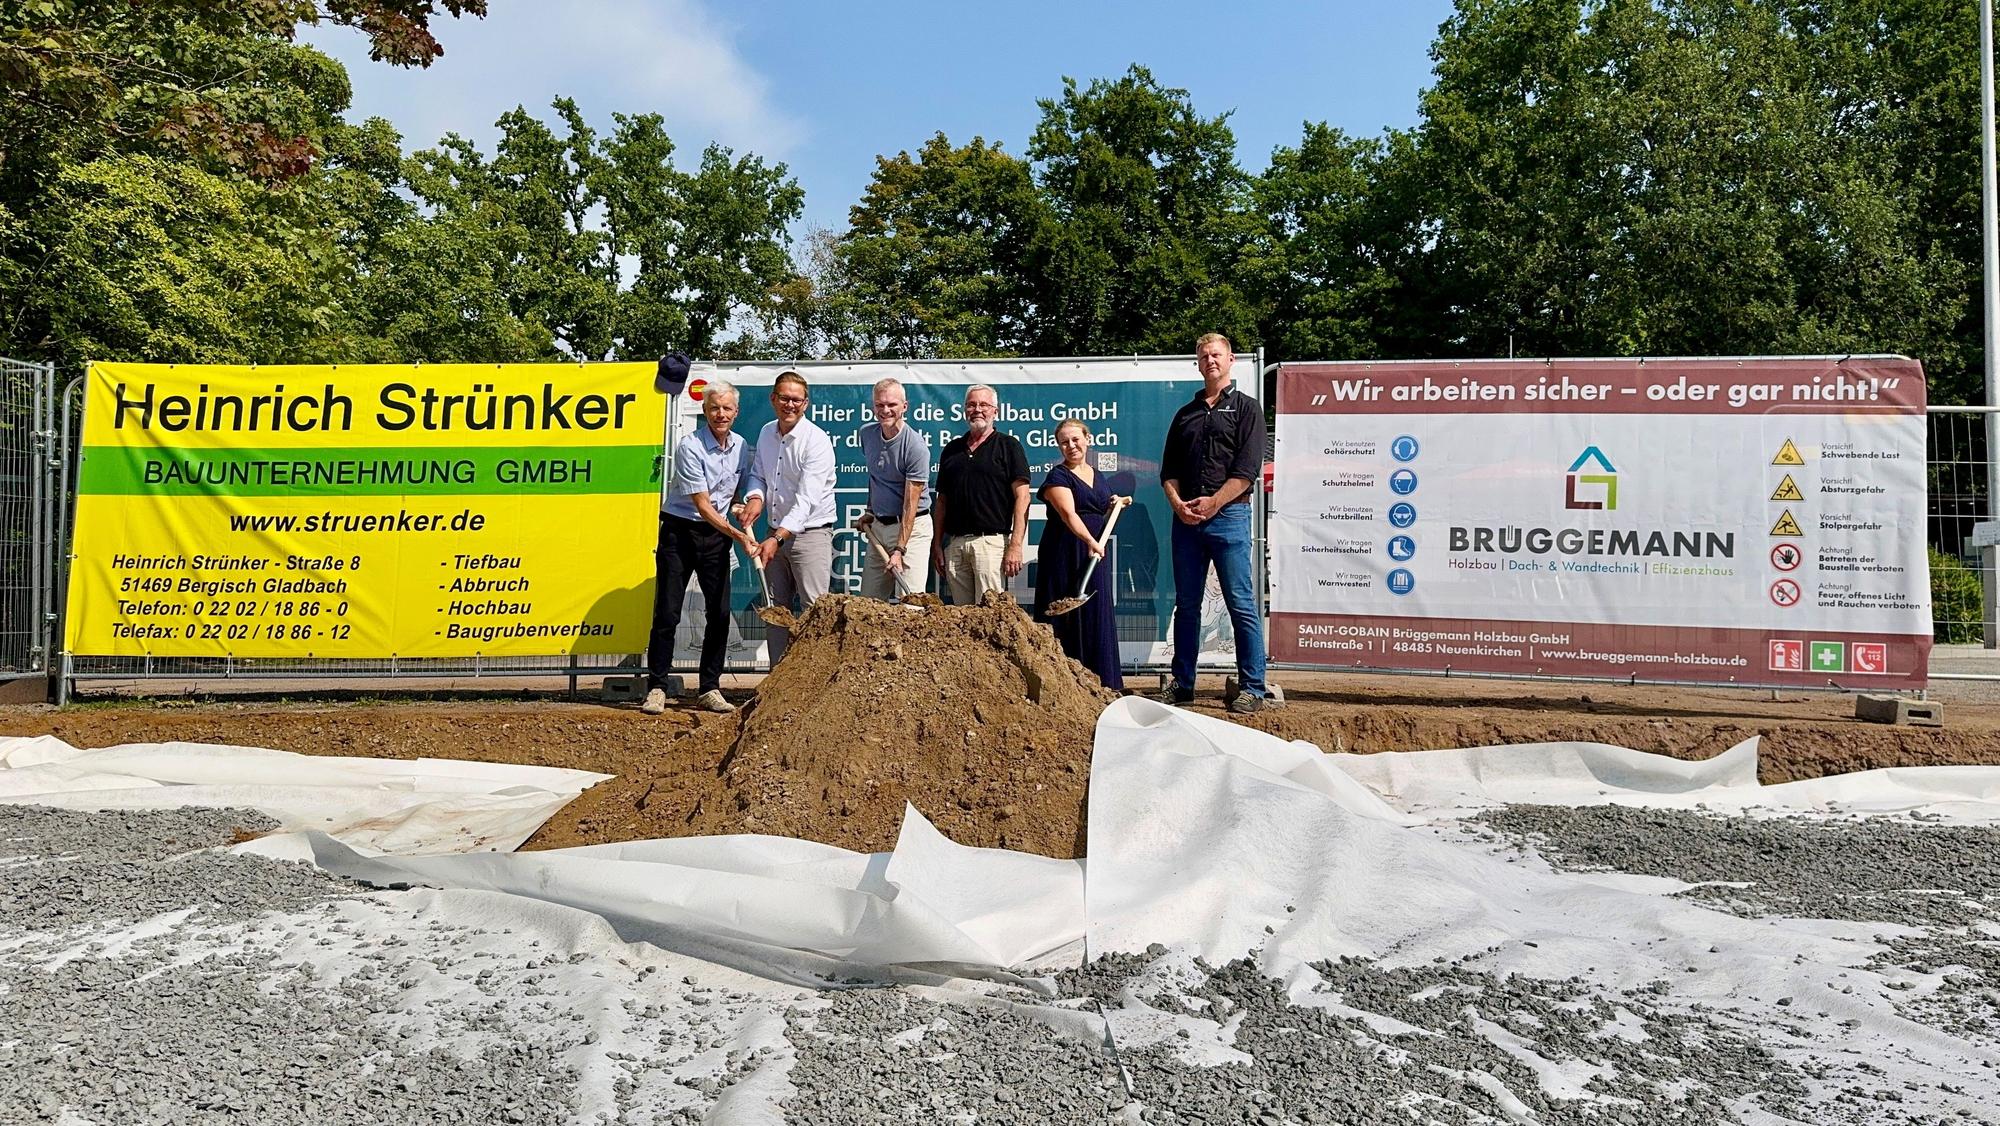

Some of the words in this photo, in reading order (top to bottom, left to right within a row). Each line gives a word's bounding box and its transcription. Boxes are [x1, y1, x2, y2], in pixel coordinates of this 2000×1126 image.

[1391, 378, 1515, 400] arbeiten
[1524, 377, 1612, 401] sicher
[1646, 376, 1720, 400] oder
[1728, 384, 1783, 407] gar
[113, 382, 352, 432] Heinrich
[376, 382, 636, 431] Strünker
[811, 404, 855, 421] Hier
[913, 403, 945, 421] die
[951, 403, 1044, 422] Slbau
[1050, 402, 1117, 421] GmbH
[1821, 451, 1879, 459] Schwebende
[144, 460, 475, 485] BAUUNTERNEHMUNG
[496, 459, 592, 484] GMBH
[1353, 473, 1375, 481] tragen
[1820, 486, 1885, 495] Absturzgefahr
[229, 509, 485, 532] www.struenker.de
[1819, 522, 1882, 531] Stolpergefahr
[1449, 525, 1735, 558] BRÜGGEMANN
[1301, 546, 1372, 554] Sicherheitsschuhe!
[1819, 546, 1853, 555] Achtung!
[112, 555, 186, 570] Heinrich
[192, 555, 269, 570] Strünker
[286, 555, 346, 570] Straße
[349, 555, 361, 570] 8
[453, 555, 521, 569] Tiefbau
[1819, 555, 1857, 563] Betreten
[1449, 559, 1497, 570] Holzbau
[1509, 560, 1543, 571] Dach-
[1562, 560, 1640, 573] Wandtechnik
[1652, 564, 1734, 576] Effizienzhaus
[449, 577, 530, 592] Abbruch
[1350, 573, 1371, 581] tragen
[120, 577, 173, 593] 51469
[178, 577, 257, 597] Bergisch
[263, 577, 347, 593] Gladbach
[1818, 583, 1852, 592] Achtung!
[1818, 591, 1846, 600] Feuer,
[1848, 592, 1882, 600] offenes
[117, 600, 187, 616] Telefon:
[193, 601, 204, 616] 0
[207, 601, 229, 616] 22
[234, 601, 256, 616] 02
[274, 601, 294, 616] 18
[299, 601, 321, 617] 86
[337, 601, 349, 617] 0
[447, 600, 531, 615] Hochbau
[112, 623, 180, 639] Telefax:
[185, 624, 196, 639] 0
[199, 624, 221, 639] 22
[227, 624, 249, 640] 02
[265, 624, 286, 640] 18
[290, 624, 313, 640] 86
[330, 624, 351, 640] 12
[446, 622, 614, 641] Baugrubenverbau
[1299, 625, 1390, 638] SAINT-GOBAIN
[1393, 629, 1471, 642] Brüggemann
[1474, 631, 1526, 643] Holzbau
[1530, 633, 1570, 645] GmbH
[1298, 638, 1364, 650] Erlenstraße
[1367, 640, 1373, 650] 1
[1393, 642, 1432, 653] 48485
[1436, 644, 1522, 657] Neuenkirchen
[1541, 649, 1748, 667] www.brueggemann-holzbau.de
